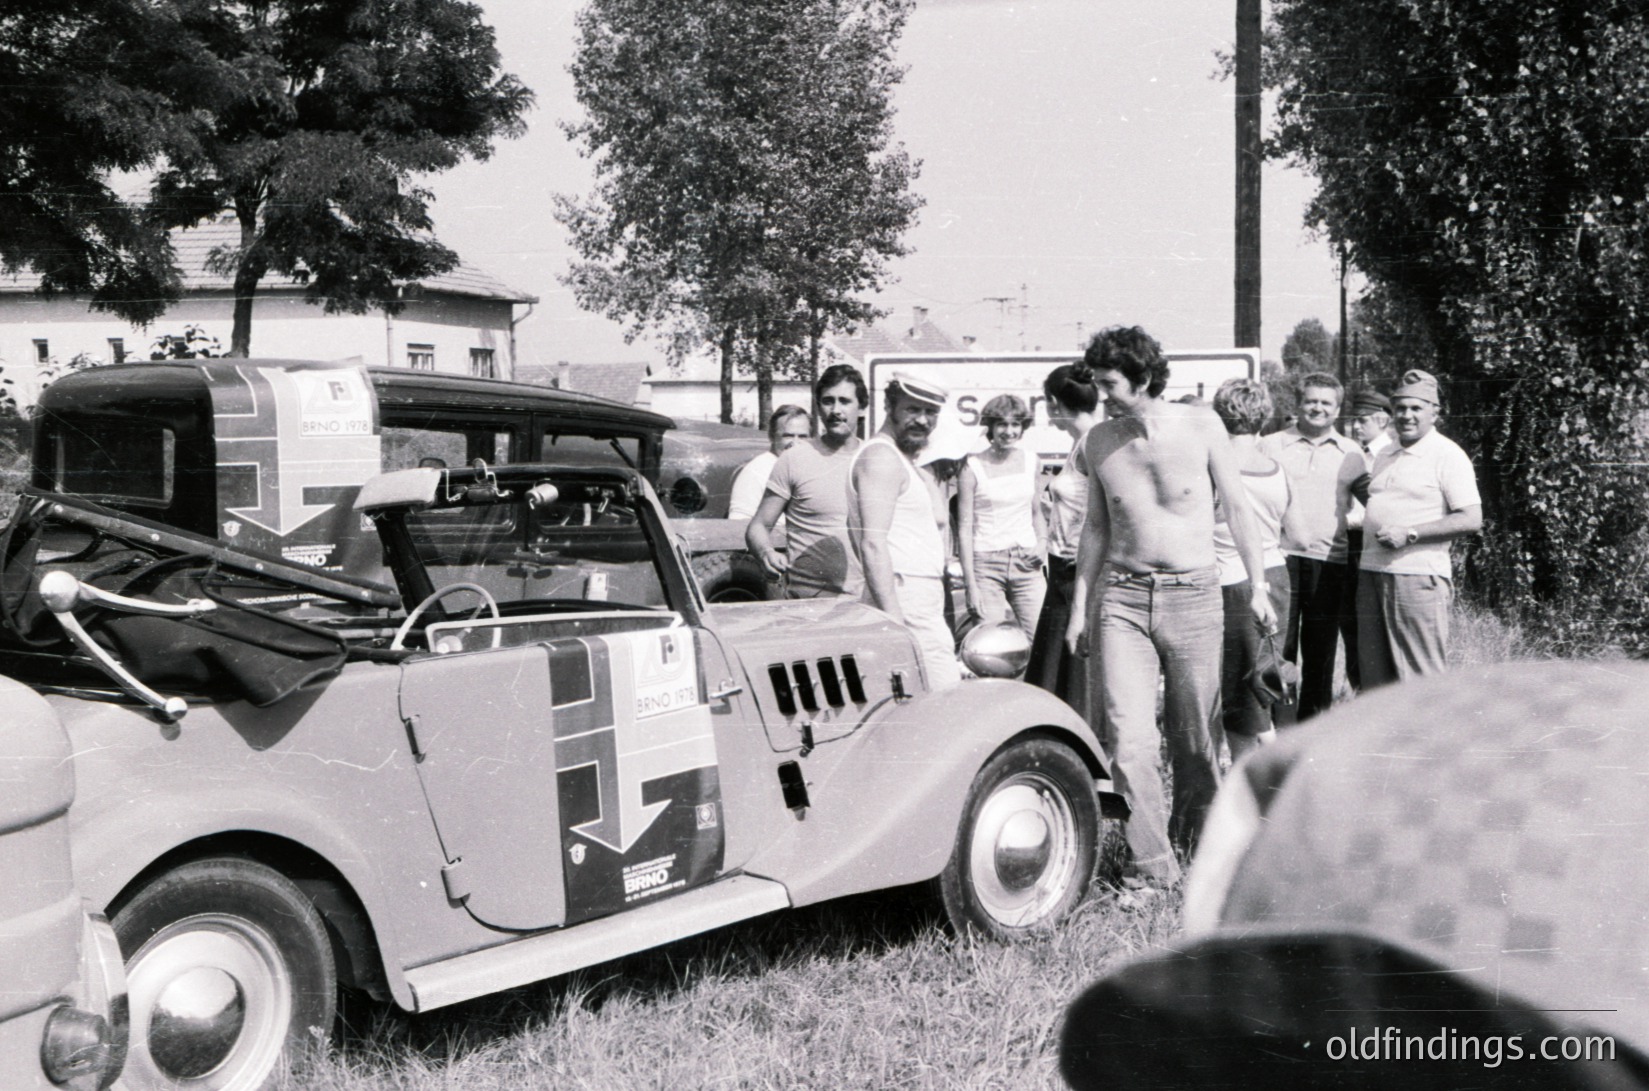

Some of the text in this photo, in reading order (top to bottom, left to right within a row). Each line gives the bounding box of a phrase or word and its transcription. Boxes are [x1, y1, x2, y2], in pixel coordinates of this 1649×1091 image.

[302, 420, 369, 432] BRNO 1978
[637, 686, 696, 713] BRNO 1978
[624, 868, 669, 895] BRNO
